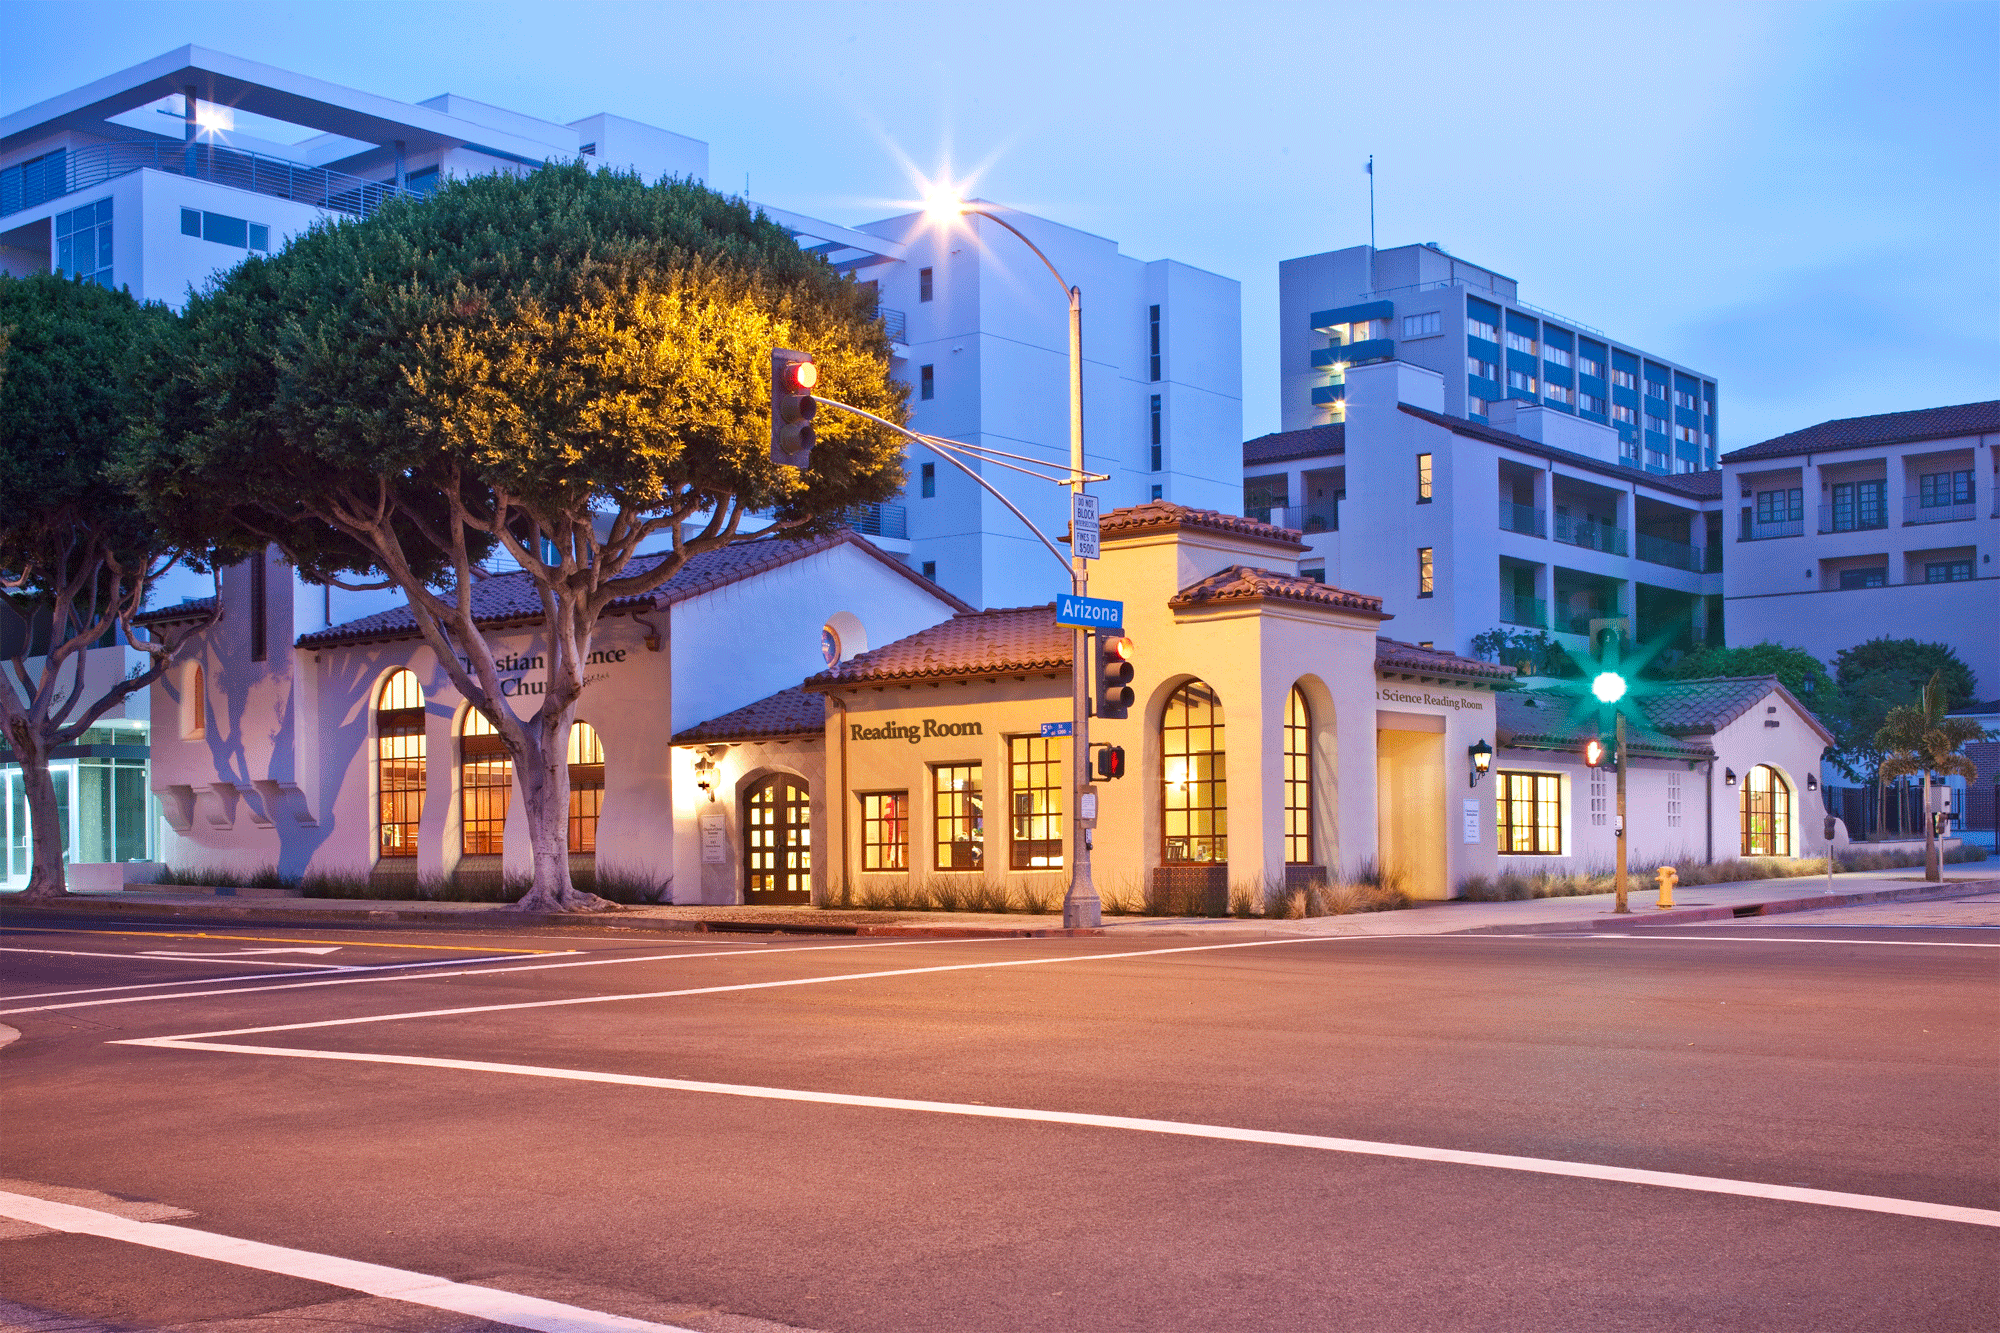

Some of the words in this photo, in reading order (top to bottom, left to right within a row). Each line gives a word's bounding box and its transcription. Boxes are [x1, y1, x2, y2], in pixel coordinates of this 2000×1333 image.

[1078, 497, 1084, 506] DO
[1085, 499, 1094, 508] NOT
[1077, 507, 1095, 520] BLOCK
[1077, 532, 1090, 542] FINES
[1091, 534, 1097, 543] TO
[1079, 542, 1095, 554] $500
[1062, 599, 1119, 622] Arizona
[1382, 688, 1422, 704] Science
[1423, 693, 1460, 710] Reading
[1460, 698, 1483, 710] Room
[850, 720, 921, 744] Reading
[922, 719, 983, 738] Room
